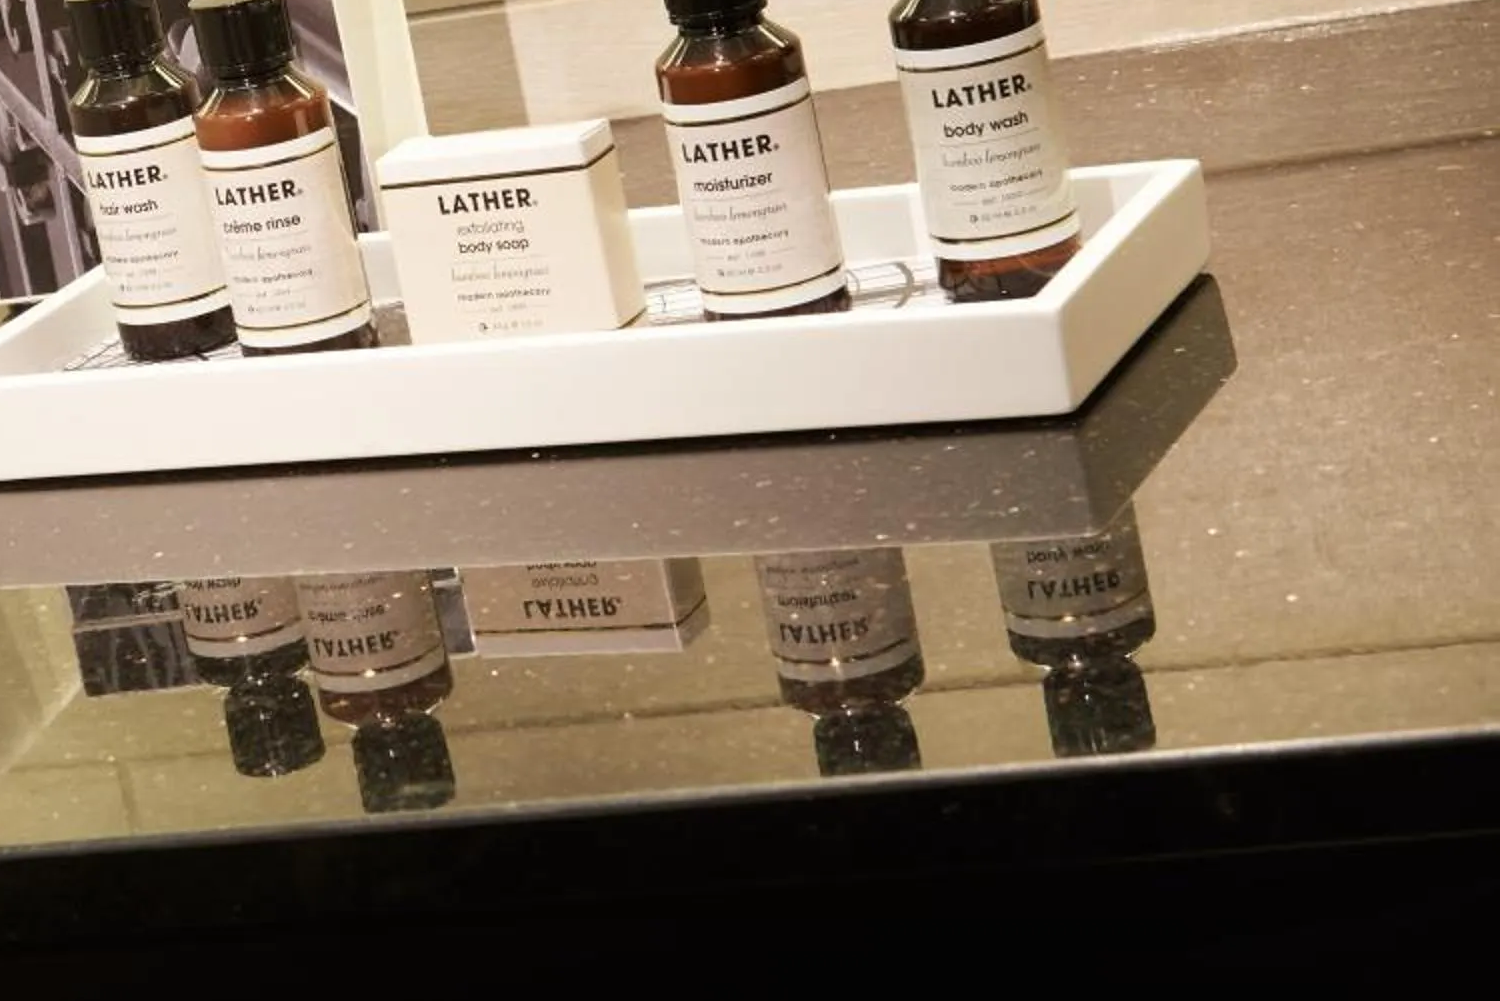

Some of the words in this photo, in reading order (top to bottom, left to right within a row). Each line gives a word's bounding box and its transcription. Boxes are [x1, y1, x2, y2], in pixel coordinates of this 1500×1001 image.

[943, 120, 985, 139] body
[988, 110, 1029, 131] wash
[693, 171, 773, 192] moisturizer
[99, 201, 121, 216] hair
[122, 198, 159, 215] wash
[265, 214, 302, 231] rinse
[456, 219, 525, 237] exfoliating
[457, 239, 493, 255] body
[495, 237, 531, 254] soap
